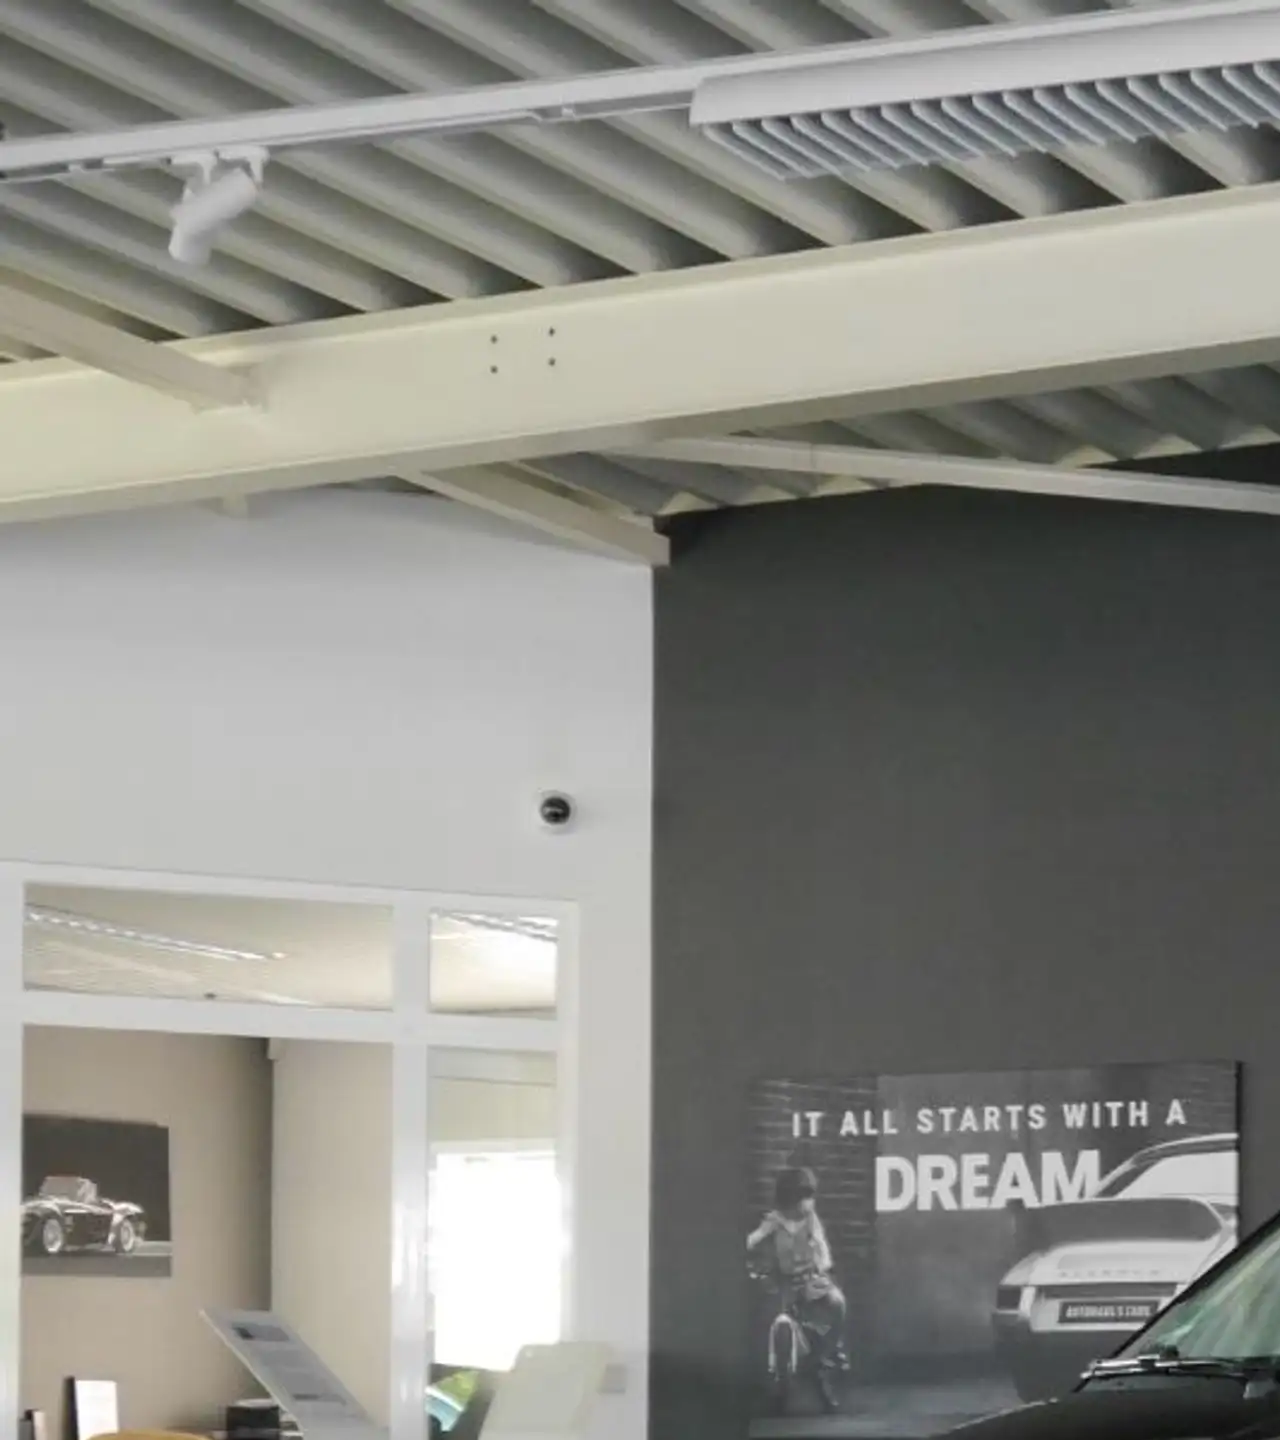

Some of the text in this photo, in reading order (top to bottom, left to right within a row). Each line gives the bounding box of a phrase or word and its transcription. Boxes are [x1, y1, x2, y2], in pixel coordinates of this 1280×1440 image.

[792, 1098, 1187, 1138] IT ALL STARTS WITH A
[875, 1148, 1100, 1213] DREAM
